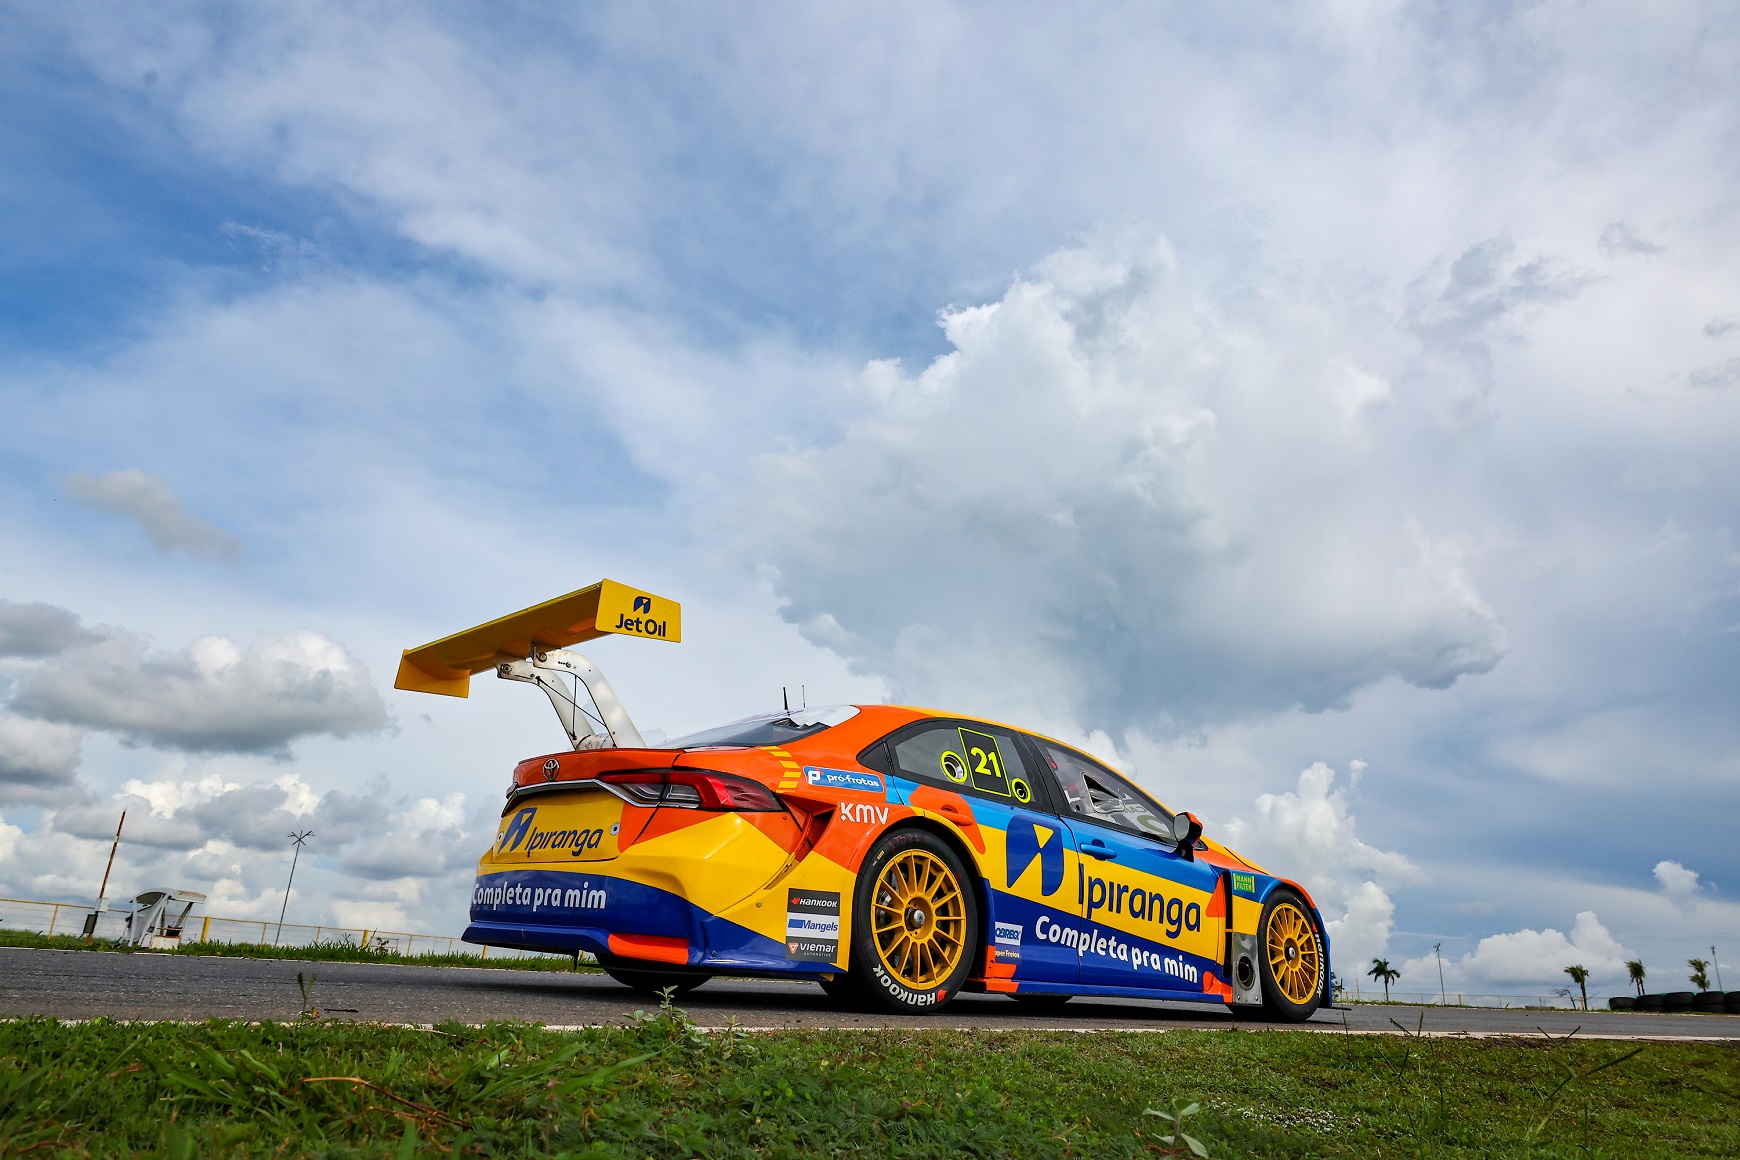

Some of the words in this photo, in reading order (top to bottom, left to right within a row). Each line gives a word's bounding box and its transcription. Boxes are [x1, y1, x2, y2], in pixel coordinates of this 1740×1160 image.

[615, 613, 643, 633] Jet
[644, 619, 666, 637] Oil
[971, 746, 1001, 778] 21
[840, 802, 889, 825] KMV
[524, 827, 604, 858] Ipiranga
[1236, 875, 1252, 884] MANN
[472, 881, 532, 911] Completa
[532, 886, 562, 912] pra
[564, 881, 607, 909] mim
[1078, 863, 1200, 939] Ipiranga
[803, 920, 839, 933] Mangels
[1035, 915, 1129, 962] Completa
[1131, 946, 1162, 971] pra
[1164, 954, 1198, 984] mim
[873, 963, 936, 1006] Hankook
